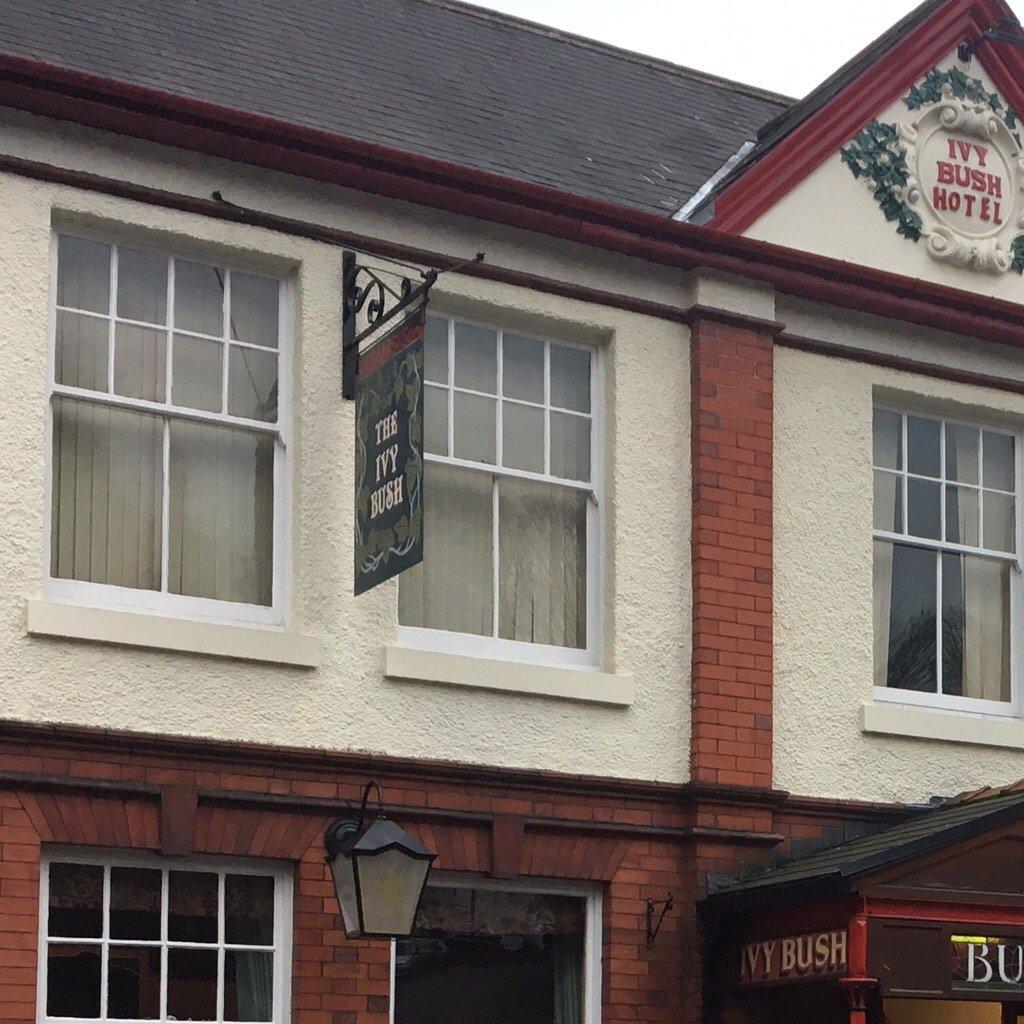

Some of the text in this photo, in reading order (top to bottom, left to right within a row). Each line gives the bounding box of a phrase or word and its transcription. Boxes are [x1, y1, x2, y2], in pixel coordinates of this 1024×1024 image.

[947, 138, 989, 167] IVY
[936, 161, 1002, 198] BUSH
[932, 186, 1003, 225] HOTEL
[375, 410, 398, 445] THE
[375, 443, 399, 482] IVY
[371, 474, 404, 519] BUSH
[741, 931, 847, 975] IVY BUSH
